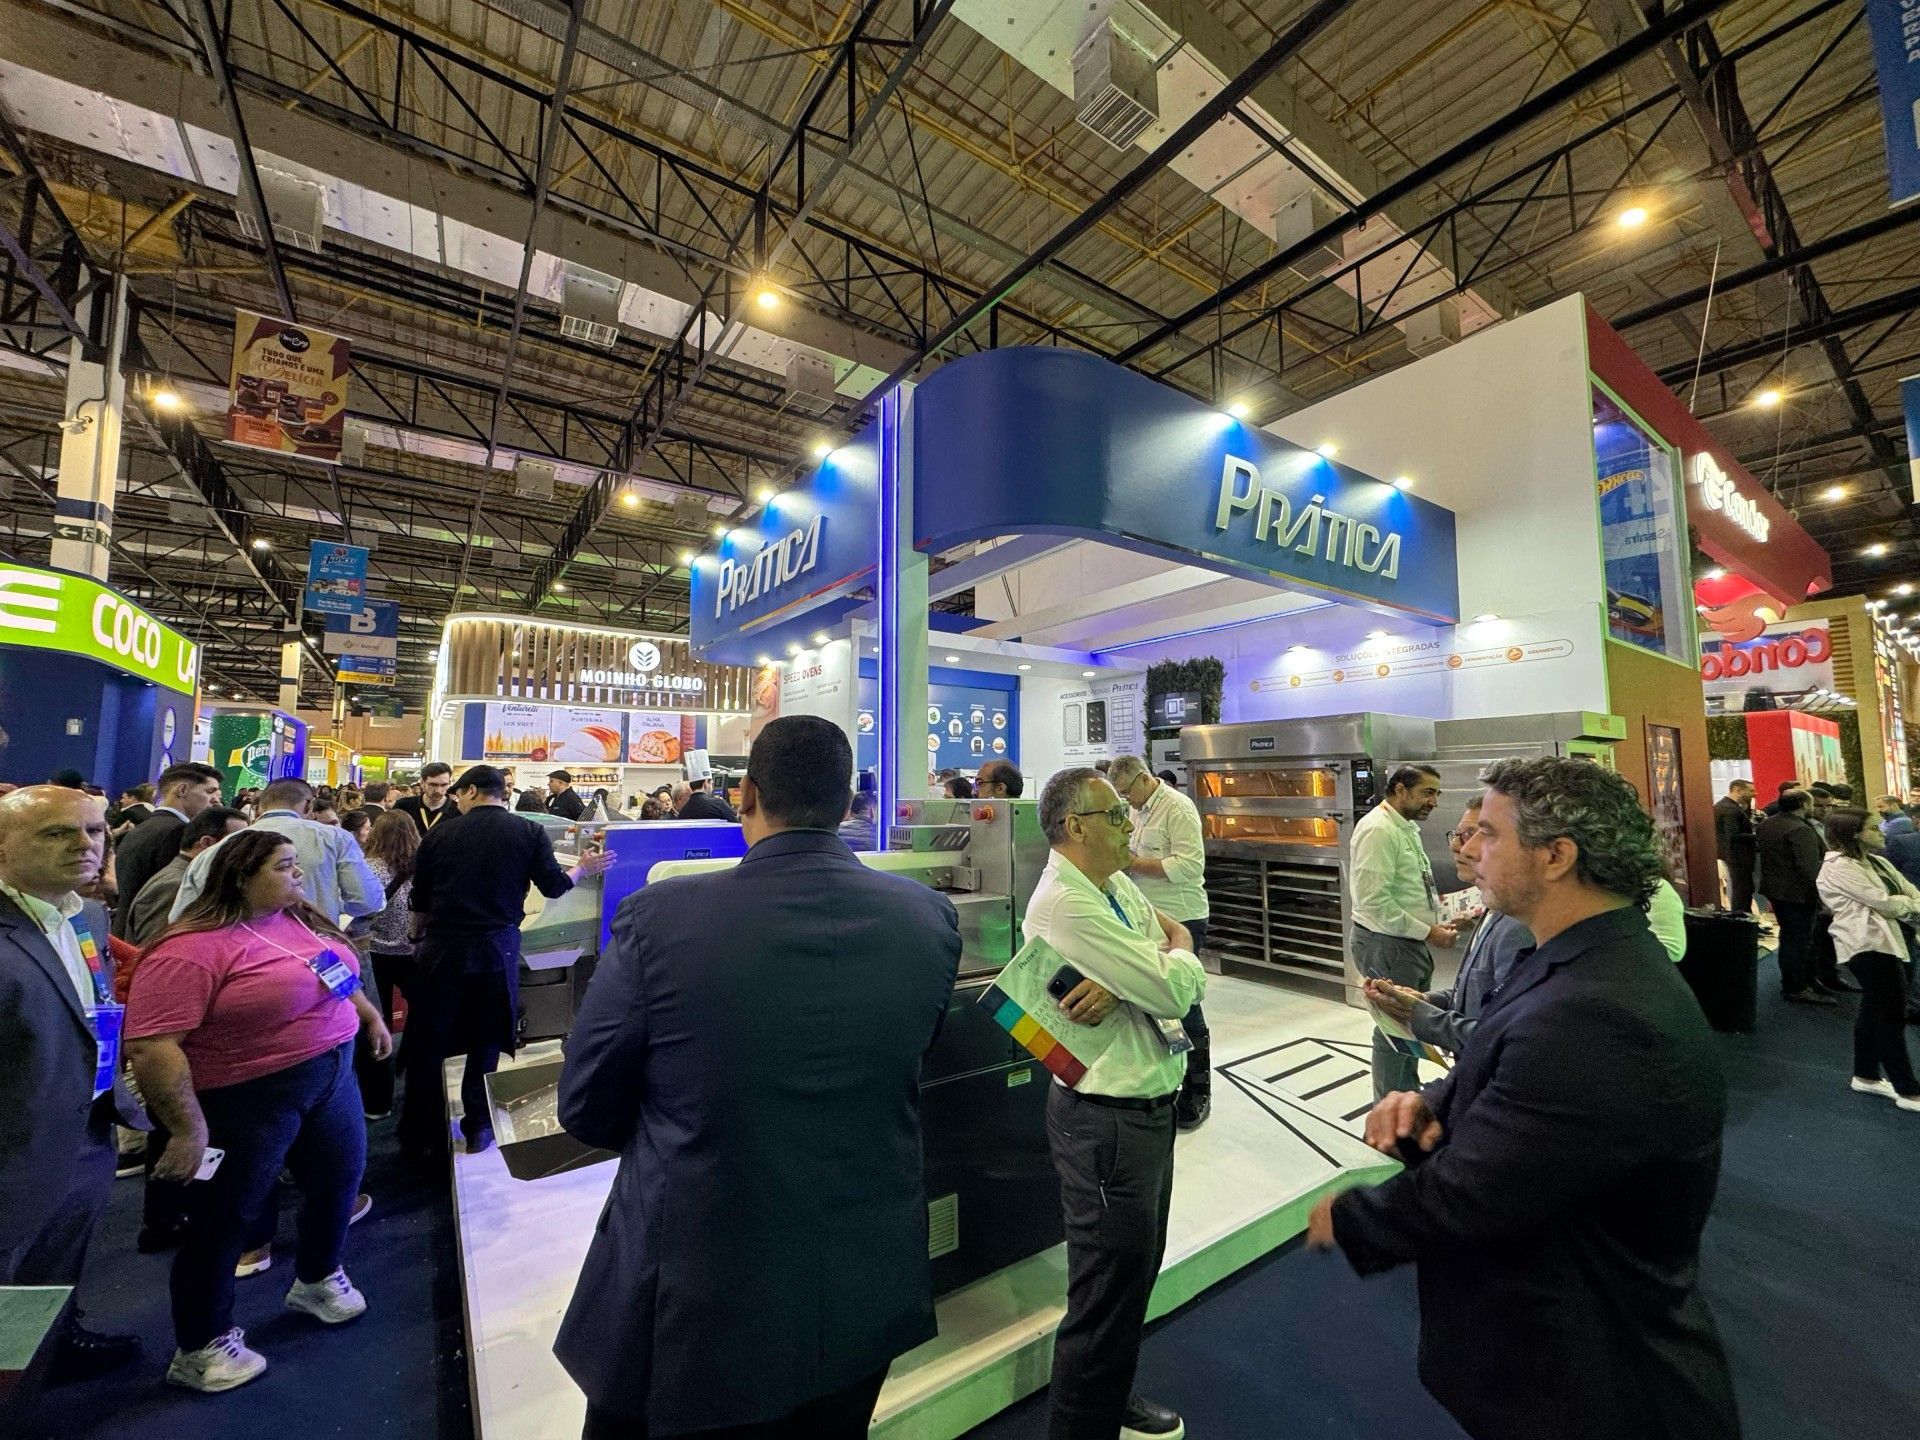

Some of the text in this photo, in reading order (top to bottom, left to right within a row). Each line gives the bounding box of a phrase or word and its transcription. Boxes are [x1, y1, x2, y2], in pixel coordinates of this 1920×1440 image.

[261, 348, 303, 364] TUDO QUE
[261, 355, 299, 371] CRIAMOS
[350, 607, 377, 633] B
[92, 593, 161, 669] COCO
[1335, 650, 1380, 663] SOLUÇÕE
[1527, 645, 1564, 656] ASSAMENTO
[579, 668, 704, 690] MOINHO GLOBO
[783, 665, 822, 685] SPEED OVENS
